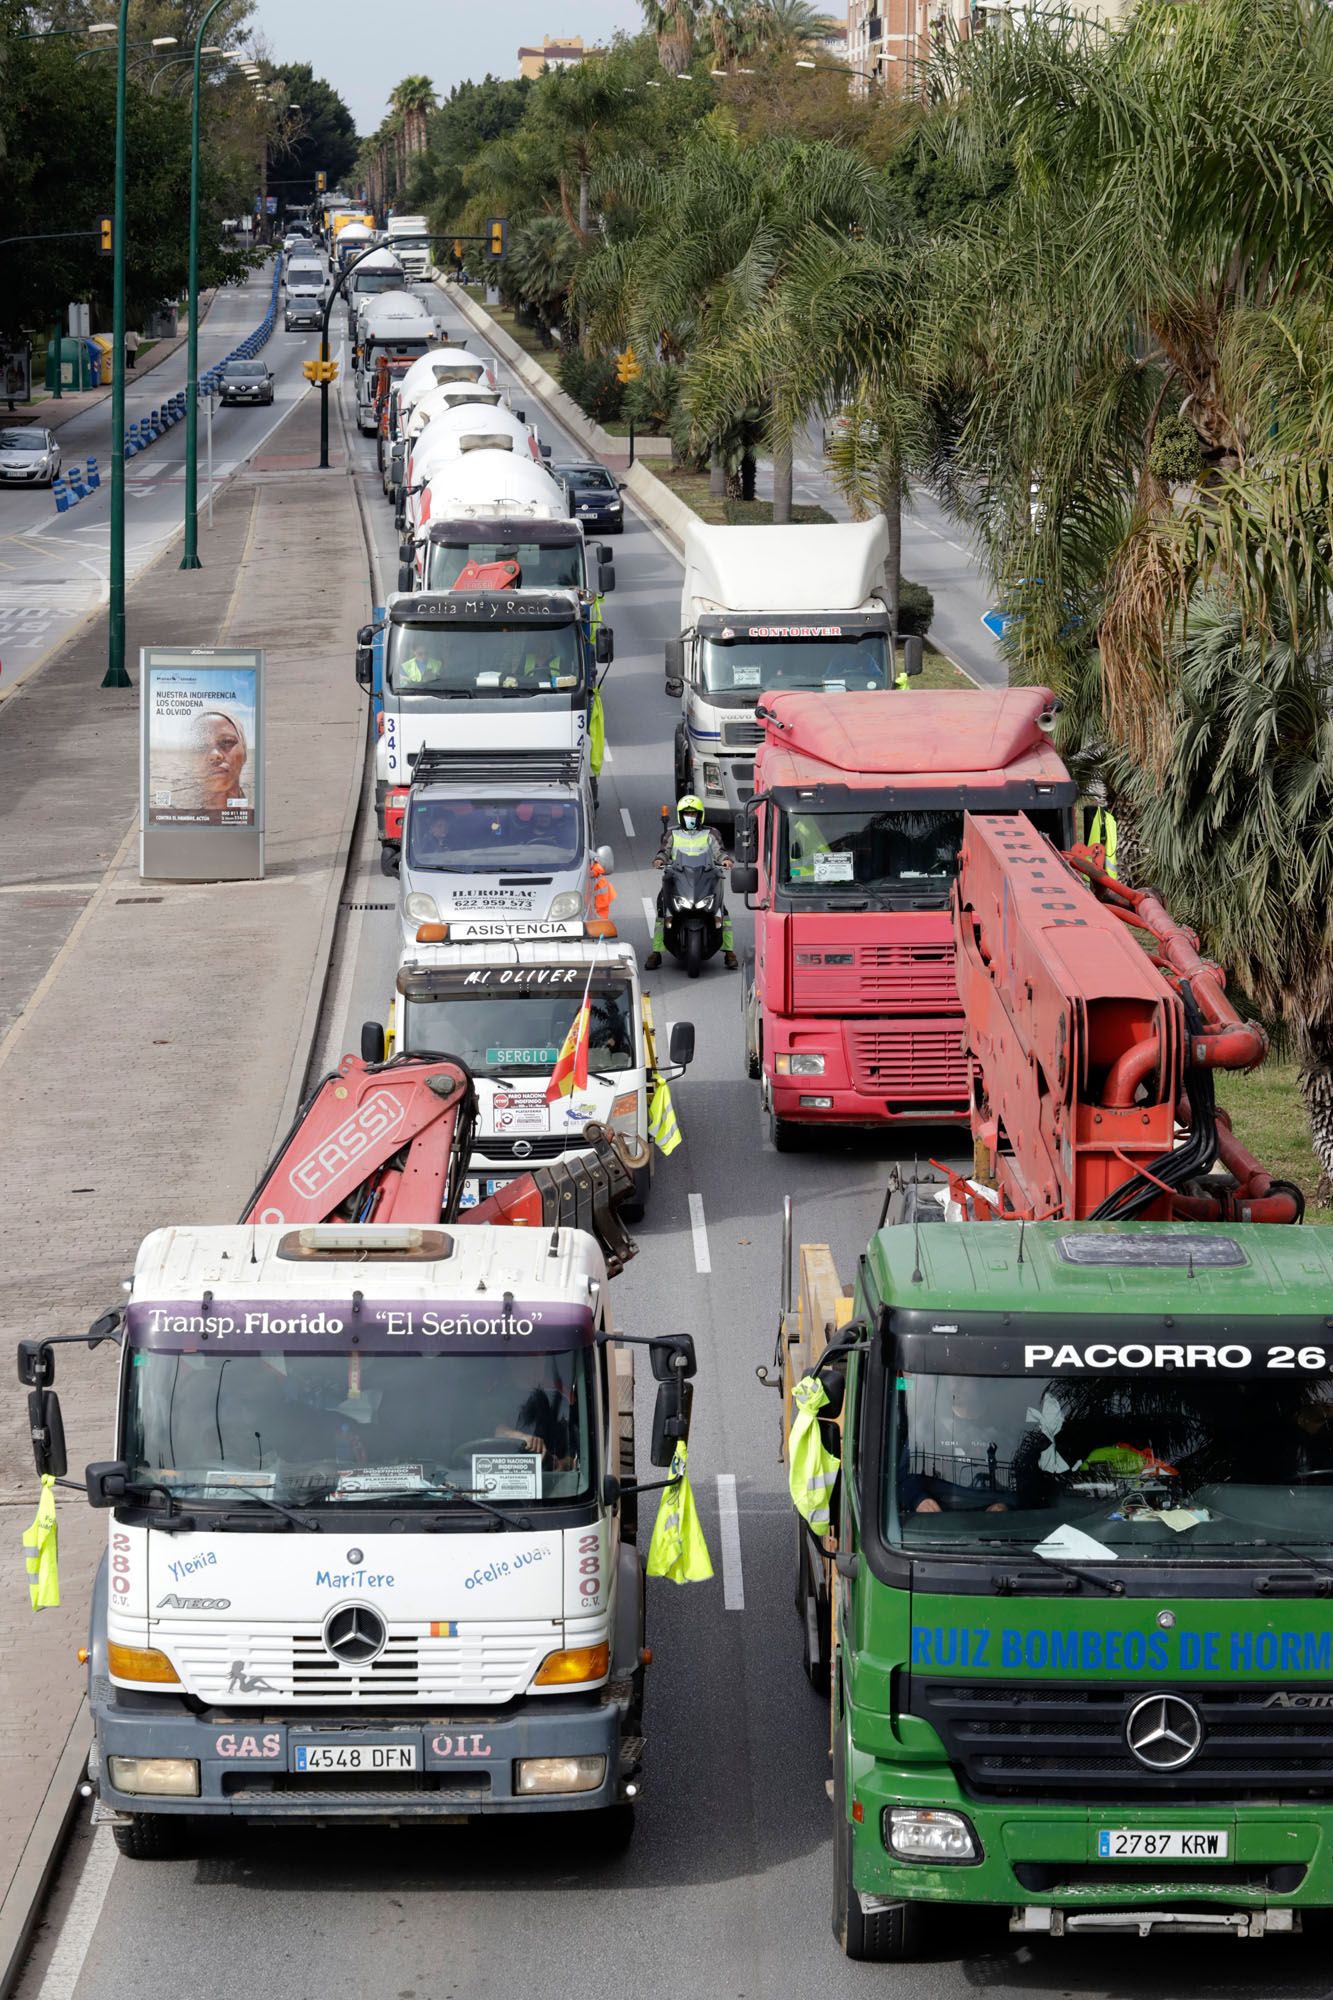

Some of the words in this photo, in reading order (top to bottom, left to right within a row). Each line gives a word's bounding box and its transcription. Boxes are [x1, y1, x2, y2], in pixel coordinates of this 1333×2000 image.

[417, 601, 457, 614] Celia
[490, 603, 499, 618] y
[748, 627, 842, 637] CONTORVER
[156, 691, 188, 699] NUESTRA
[189, 691, 237, 699] INDIFERENCIA
[156, 708, 165, 716] AL
[166, 708, 192, 716] OLVIDO
[985, 818, 1088, 926] HORMIGON
[452, 890, 536, 898] ILUROPLAC
[455, 899, 478, 907] 622
[510, 900, 533, 908] 573
[466, 923, 567, 936] ASISTENCIA
[464, 970, 491, 985] MI
[500, 969, 577, 984] OLIVER
[497, 1050, 548, 1063] SERGIO
[298, 1098, 397, 1191] FASSI
[1024, 1344, 1252, 1369] PACORRO
[1266, 1346, 1326, 1369] 26
[112, 1533, 131, 1594] 280
[578, 1535, 601, 1596] 280
[316, 1570, 395, 1588] MariTere
[911, 1625, 991, 1668] RUIZ
[1002, 1628, 1169, 1671] BOMBEOS
[1179, 1631, 1221, 1671] DE
[215, 1733, 281, 1758] GAS
[431, 1733, 492, 1757] OIL
[309, 1749, 361, 1768] 4548
[372, 1748, 412, 1768] DFN
[1115, 1834, 1171, 1854] 2787
[1181, 1834, 1218, 1854] KRW
